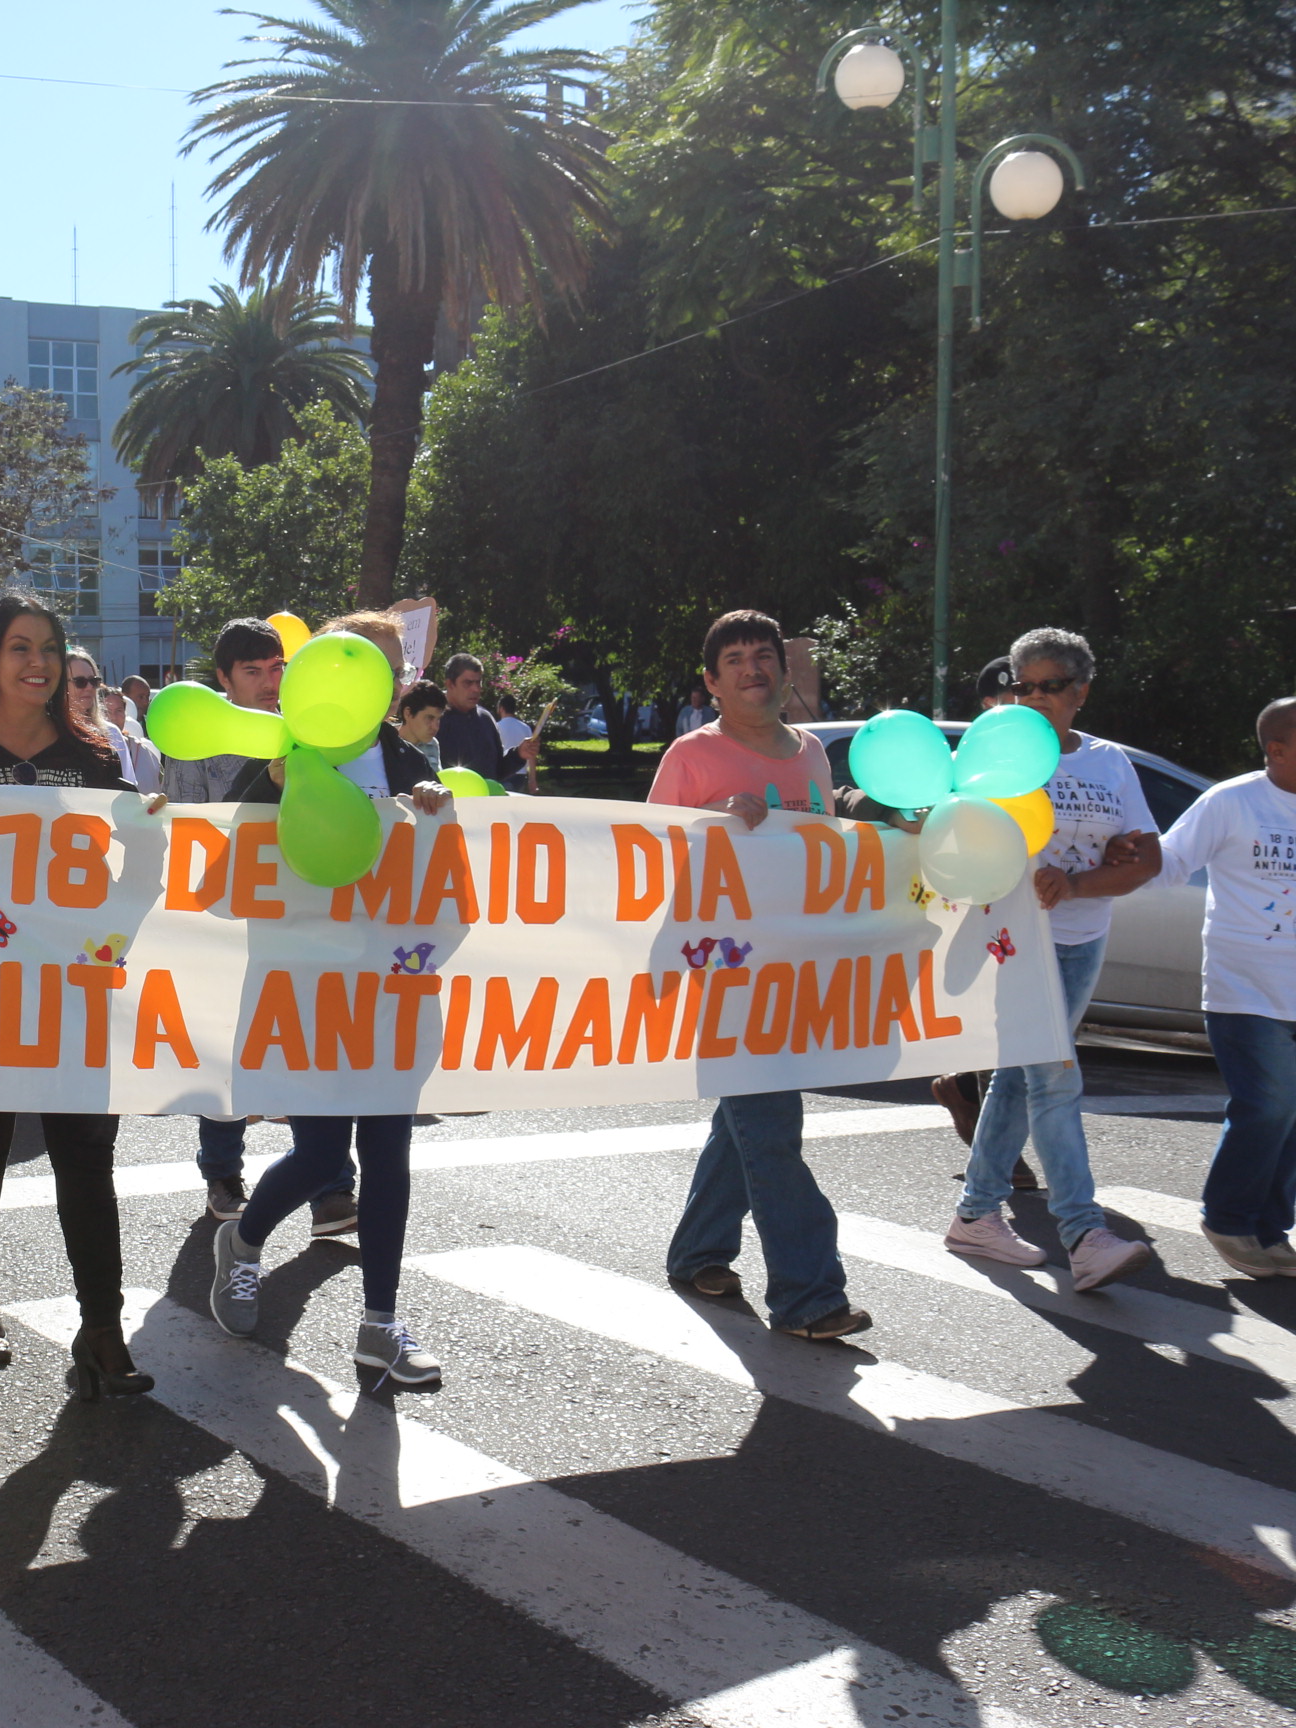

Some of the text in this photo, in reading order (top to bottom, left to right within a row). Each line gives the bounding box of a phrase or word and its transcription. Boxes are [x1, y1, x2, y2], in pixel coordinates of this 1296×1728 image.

[1057, 781, 1072, 789] DE
[1077, 781, 1107, 791] MAIO
[1057, 790, 1079, 801] DA
[1085, 790, 1122, 806] LUTA
[1054, 801, 1124, 818] MANICOMIAL
[1270, 833, 1296, 845] 18 D
[1253, 845, 1294, 859] DIA D
[164, 817, 286, 920] DE
[329, 821, 566, 926] MAIO
[610, 822, 753, 923] DIA
[794, 821, 886, 915] DA
[239, 949, 963, 1072] ANTIMANICOMIAL
